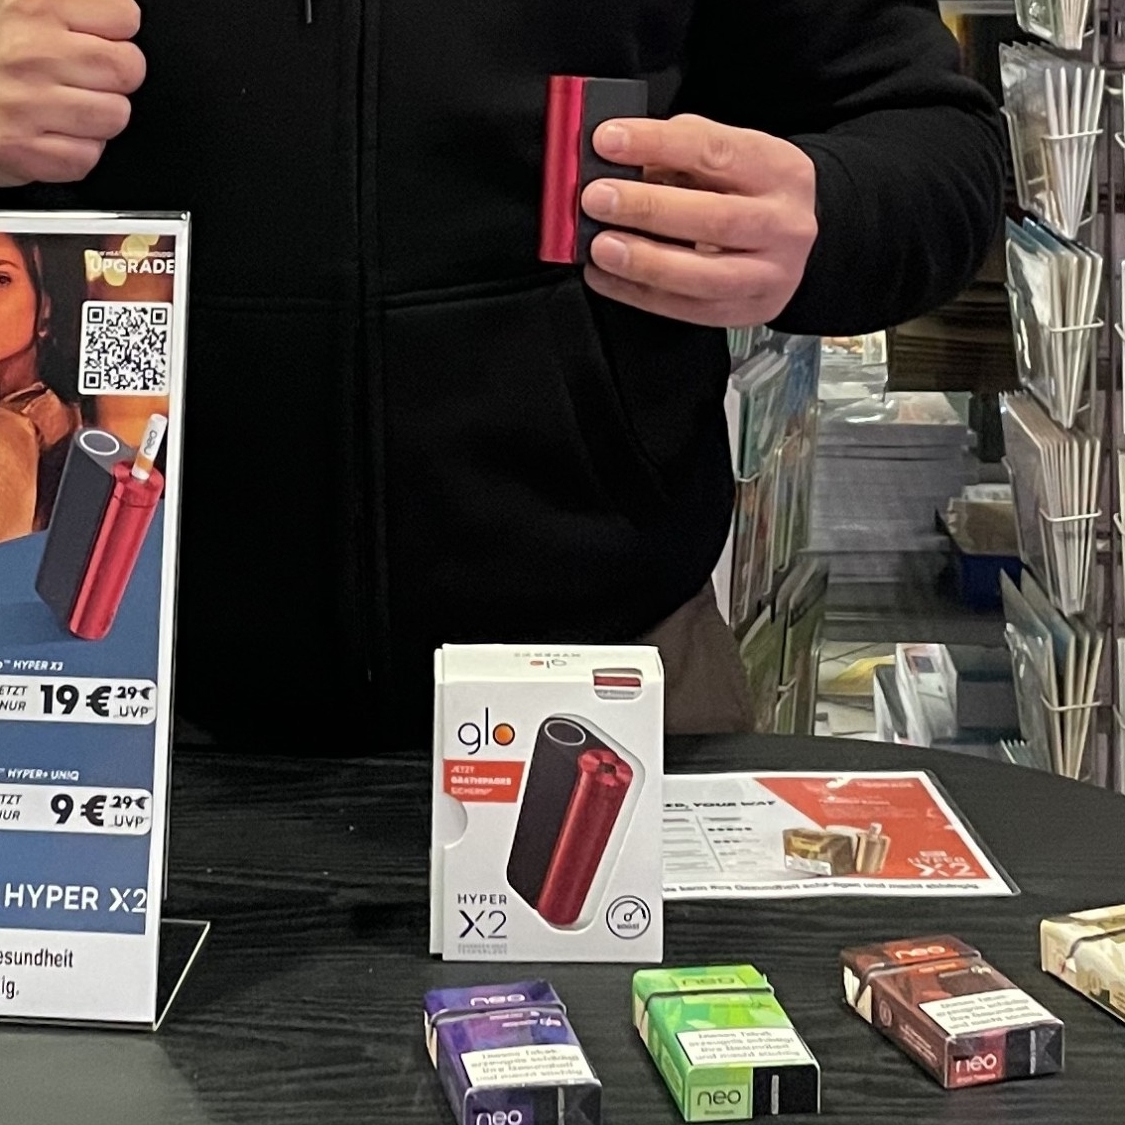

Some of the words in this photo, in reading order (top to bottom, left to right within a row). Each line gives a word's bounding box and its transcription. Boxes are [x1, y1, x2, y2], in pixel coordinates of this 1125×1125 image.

[90, 258, 176, 275] UPGRADE
[13, 660, 48, 671] HYPER
[40, 683, 80, 715] 19
[85, 685, 112, 717] €
[457, 706, 516, 756] glo
[50, 793, 74, 825] 9
[80, 794, 107, 827] €
[4, 882, 99, 911] HYPER
[108, 887, 147, 913] X2
[457, 893, 507, 905] HYPER
[458, 909, 507, 939] X2
[955, 1053, 997, 1073] neo
[697, 1090, 742, 1106] neo
[476, 1109, 523, 1125] neo
